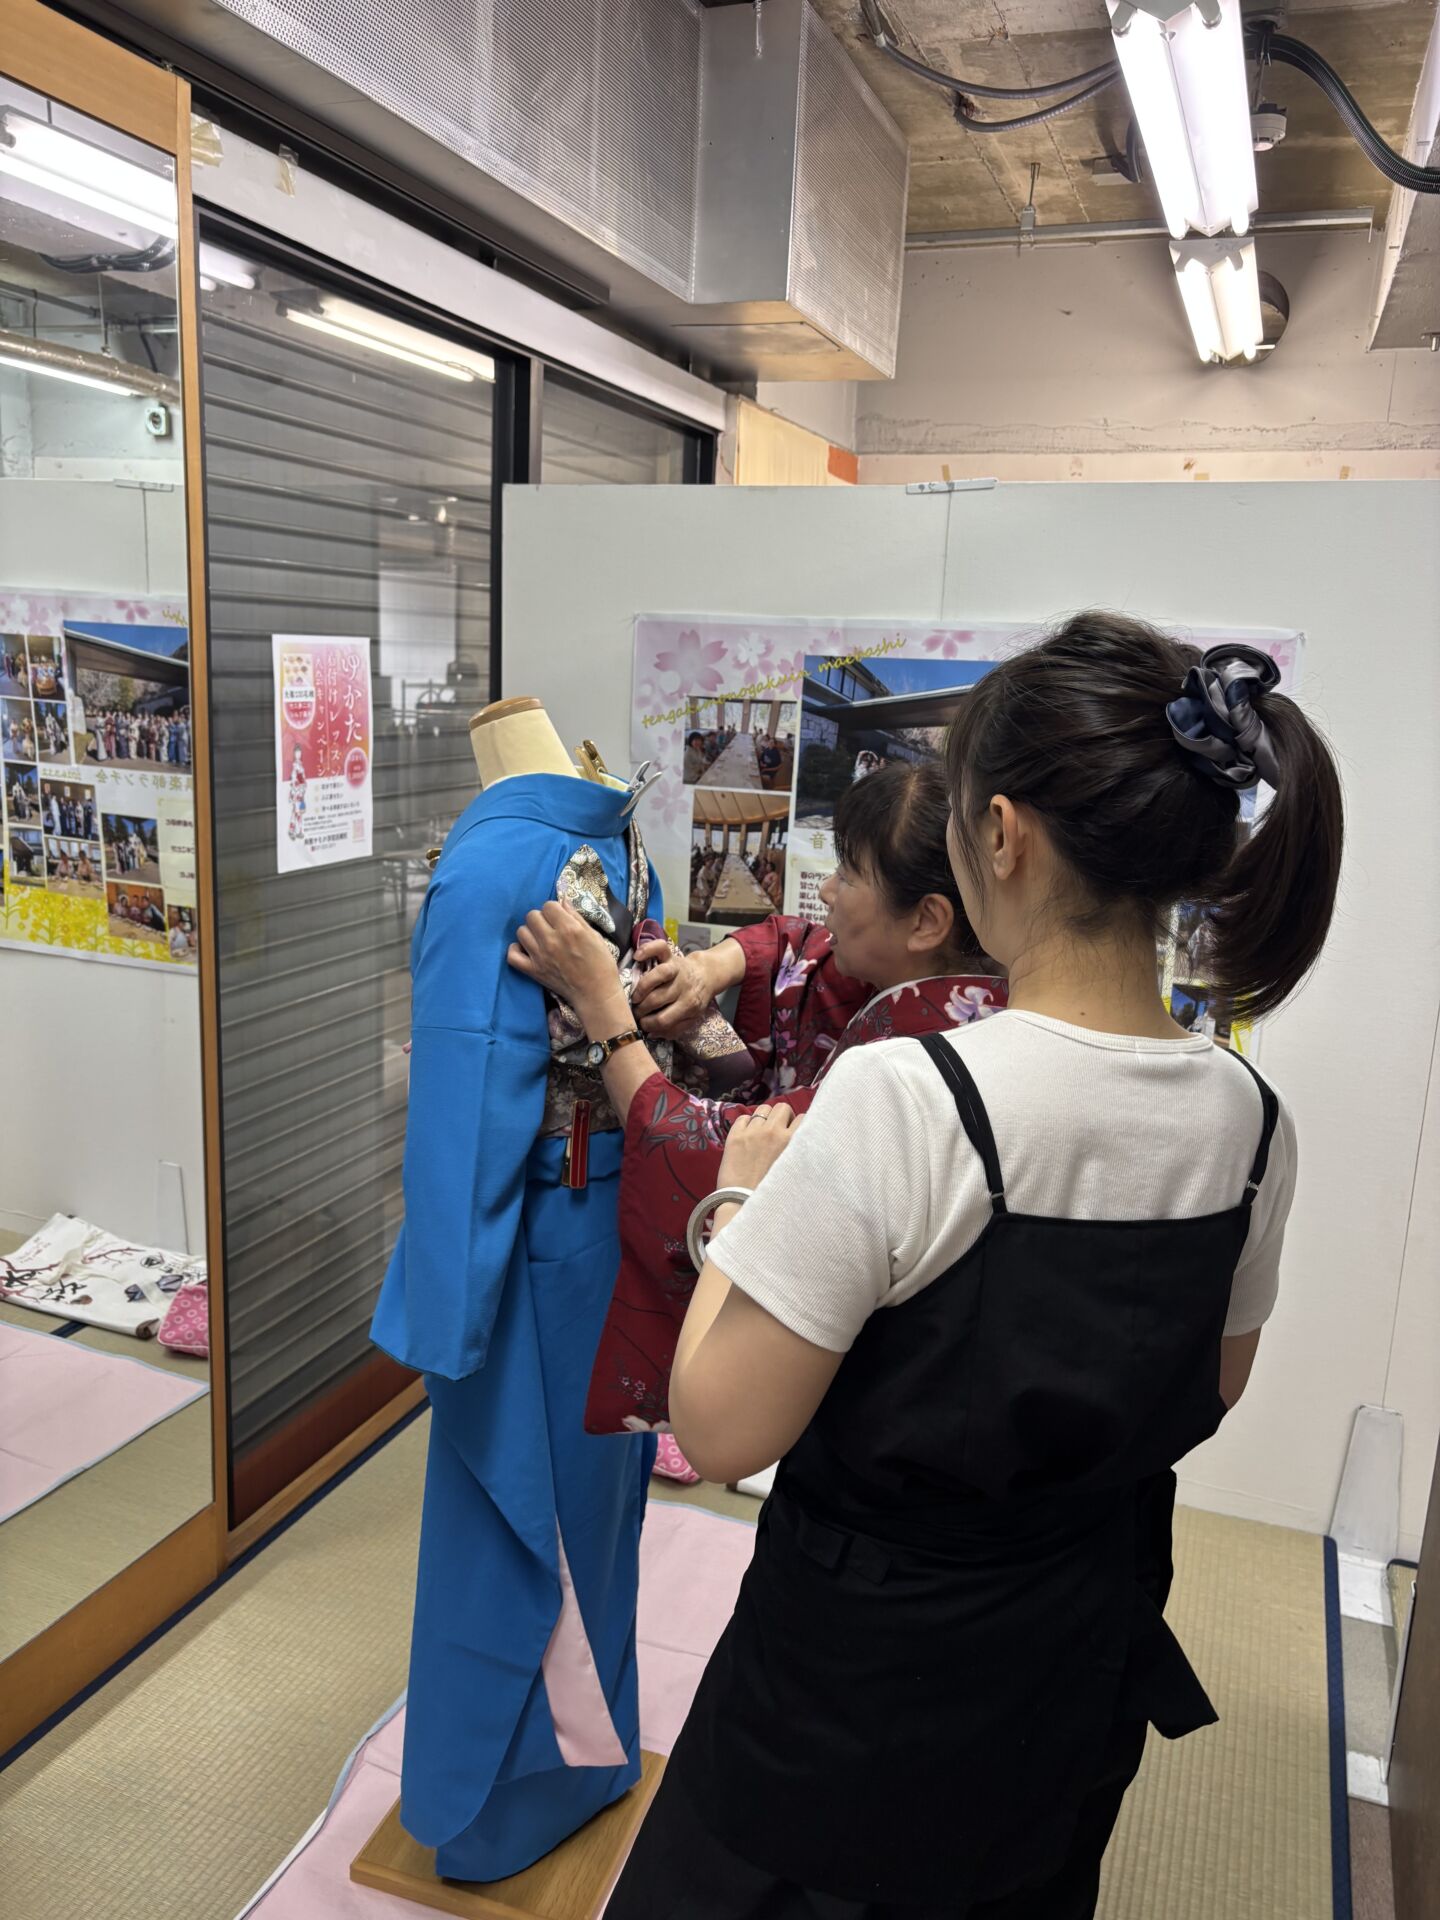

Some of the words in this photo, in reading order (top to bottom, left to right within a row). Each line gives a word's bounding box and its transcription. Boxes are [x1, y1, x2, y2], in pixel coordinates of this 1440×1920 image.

[818, 632, 908, 674] maebashi
[341, 655, 363, 742] ゆかた
[800, 871, 831, 880] 春のラン
